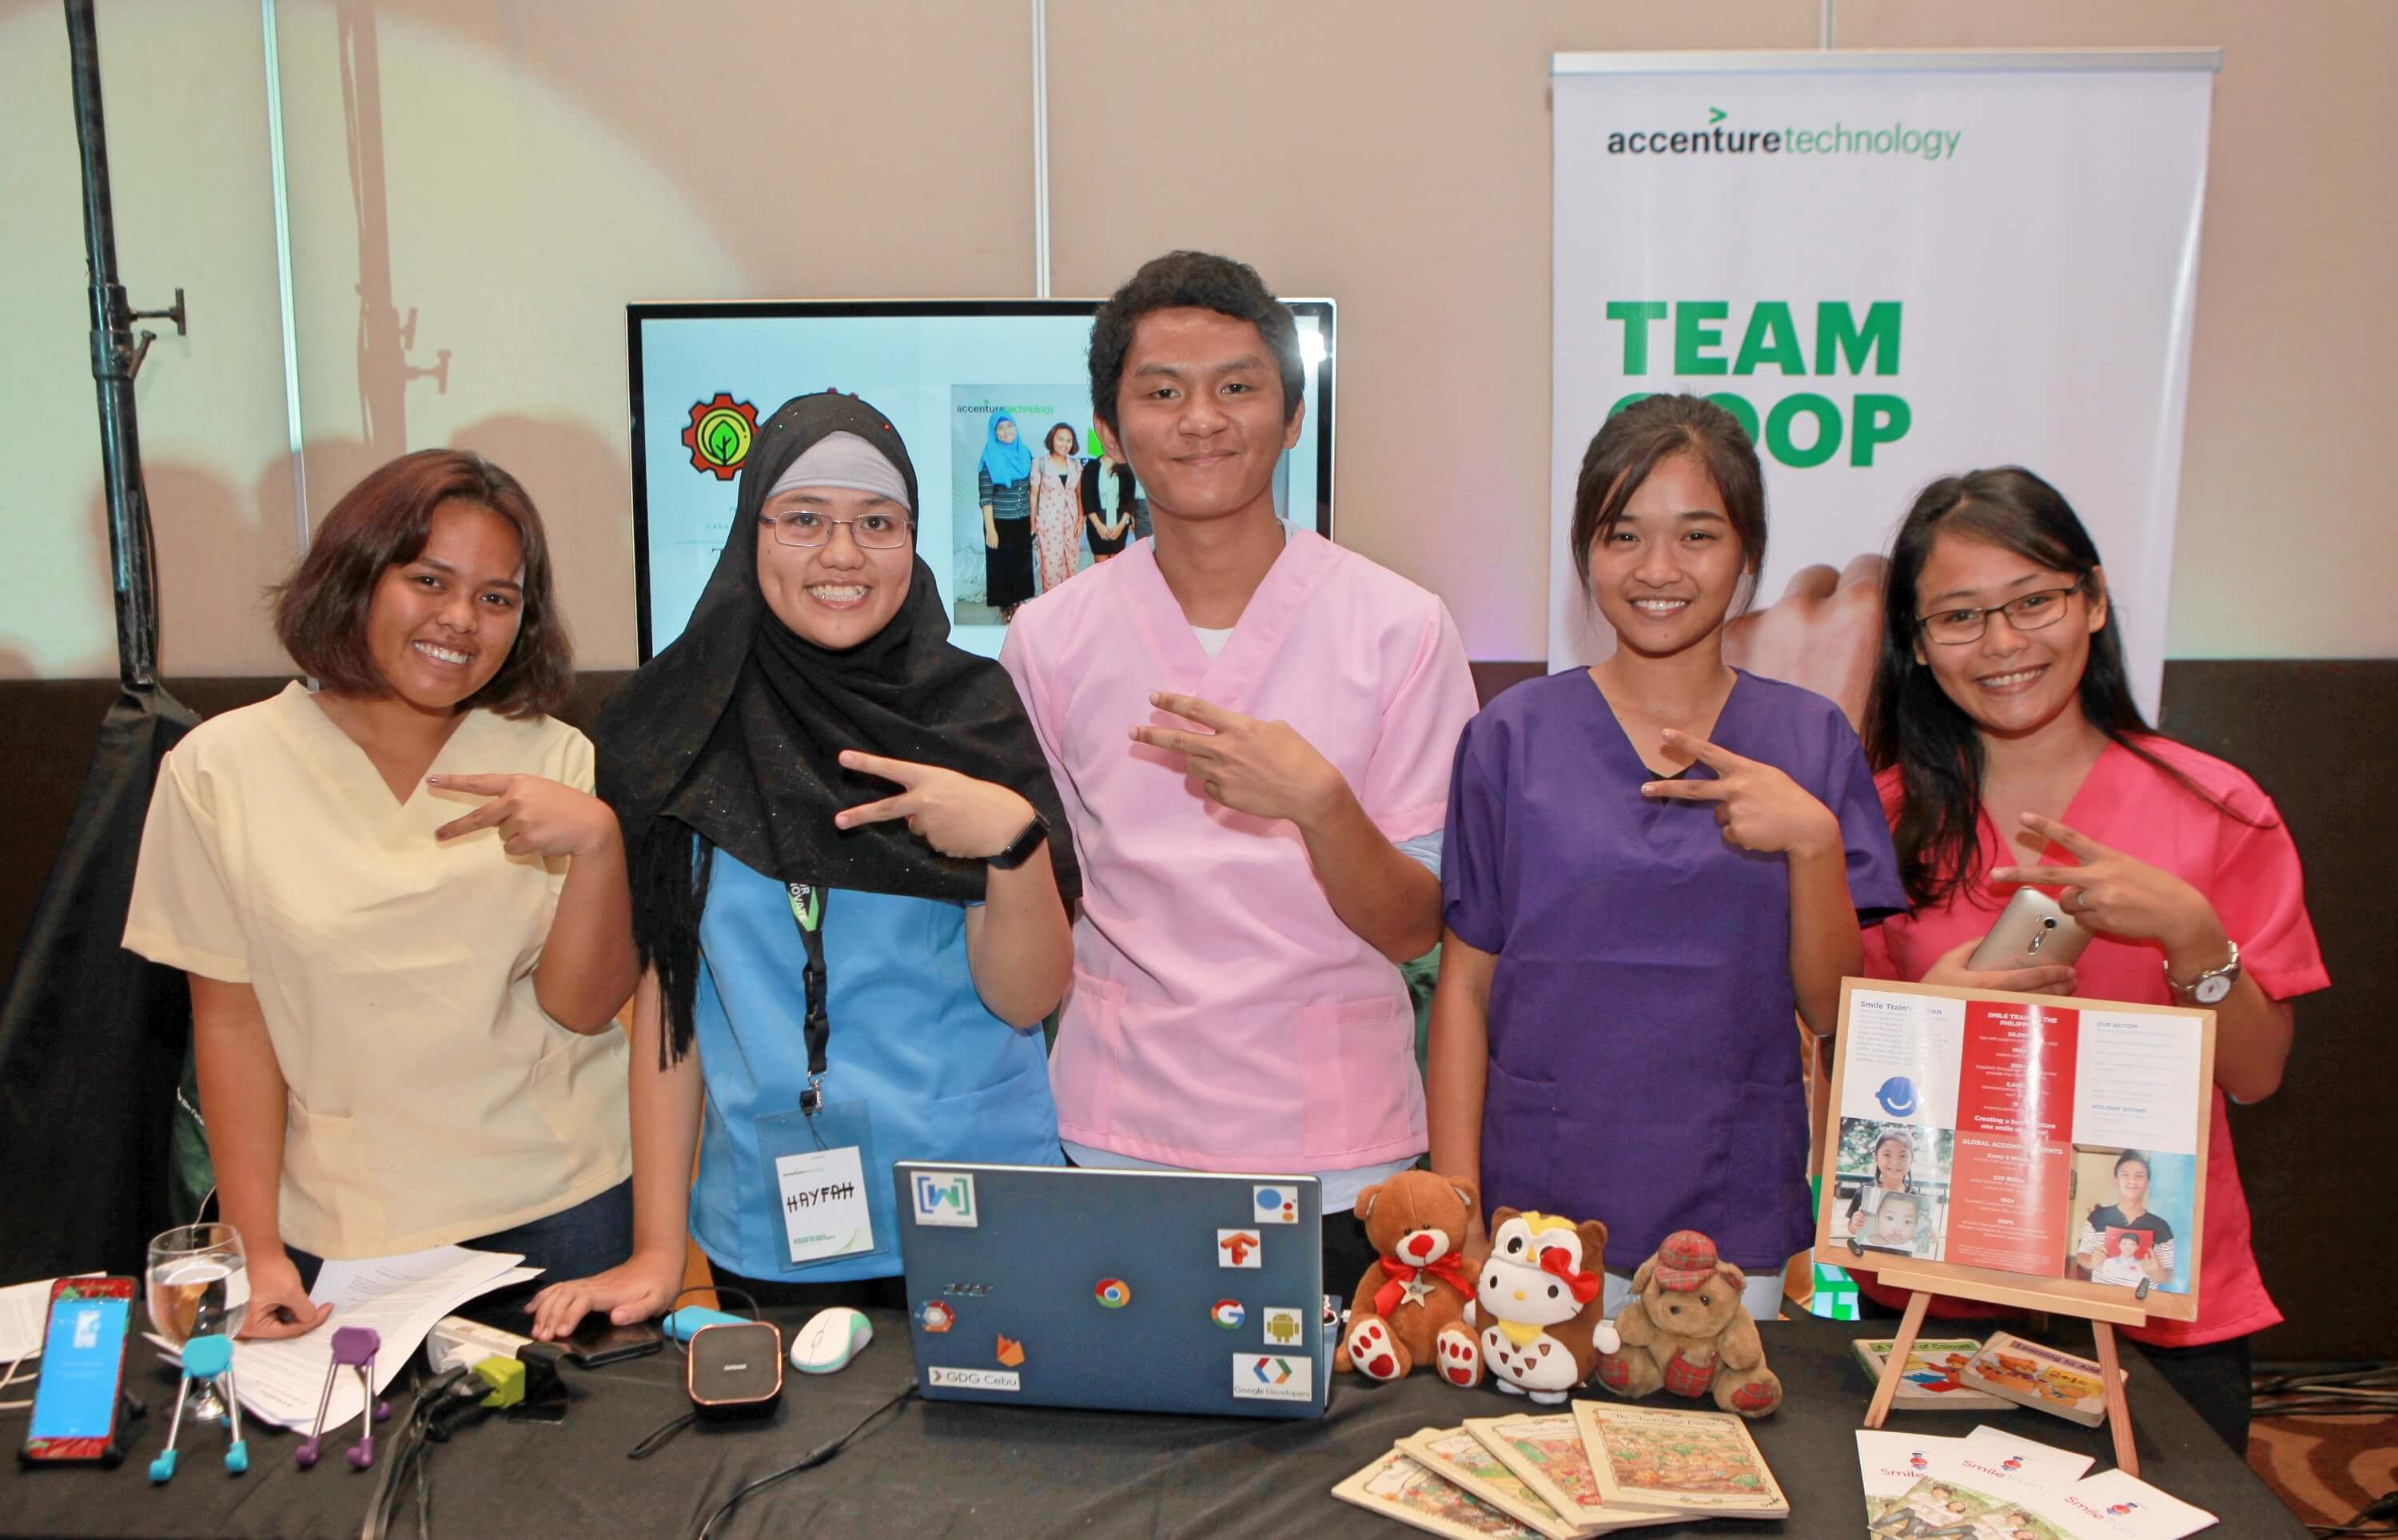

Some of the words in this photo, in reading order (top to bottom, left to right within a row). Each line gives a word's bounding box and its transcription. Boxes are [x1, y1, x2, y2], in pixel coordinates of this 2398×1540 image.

[1607, 301, 1902, 376] TEAM
[1607, 392, 1912, 468] OP
[1860, 1001, 1884, 1009] Smile
[1974, 1115, 2004, 1124] Creating
[1962, 1138, 1990, 1147] GLOBAL
[787, 1181, 854, 1213] HAYFAH
[2016, 1343, 2061, 1363] Learning
[2065, 1359, 2076, 1368] to
[2079, 1363, 2101, 1374] Add
[946, 1371, 980, 1384] GDG
[985, 1375, 1018, 1387] Cebu
[1233, 1386, 1264, 1395] Google
[1266, 1387, 1311, 1399] Developers
[1880, 1467, 1926, 1478] Smile
[1962, 1458, 2006, 1478] Smile
[2065, 1495, 2104, 1520] Smile
